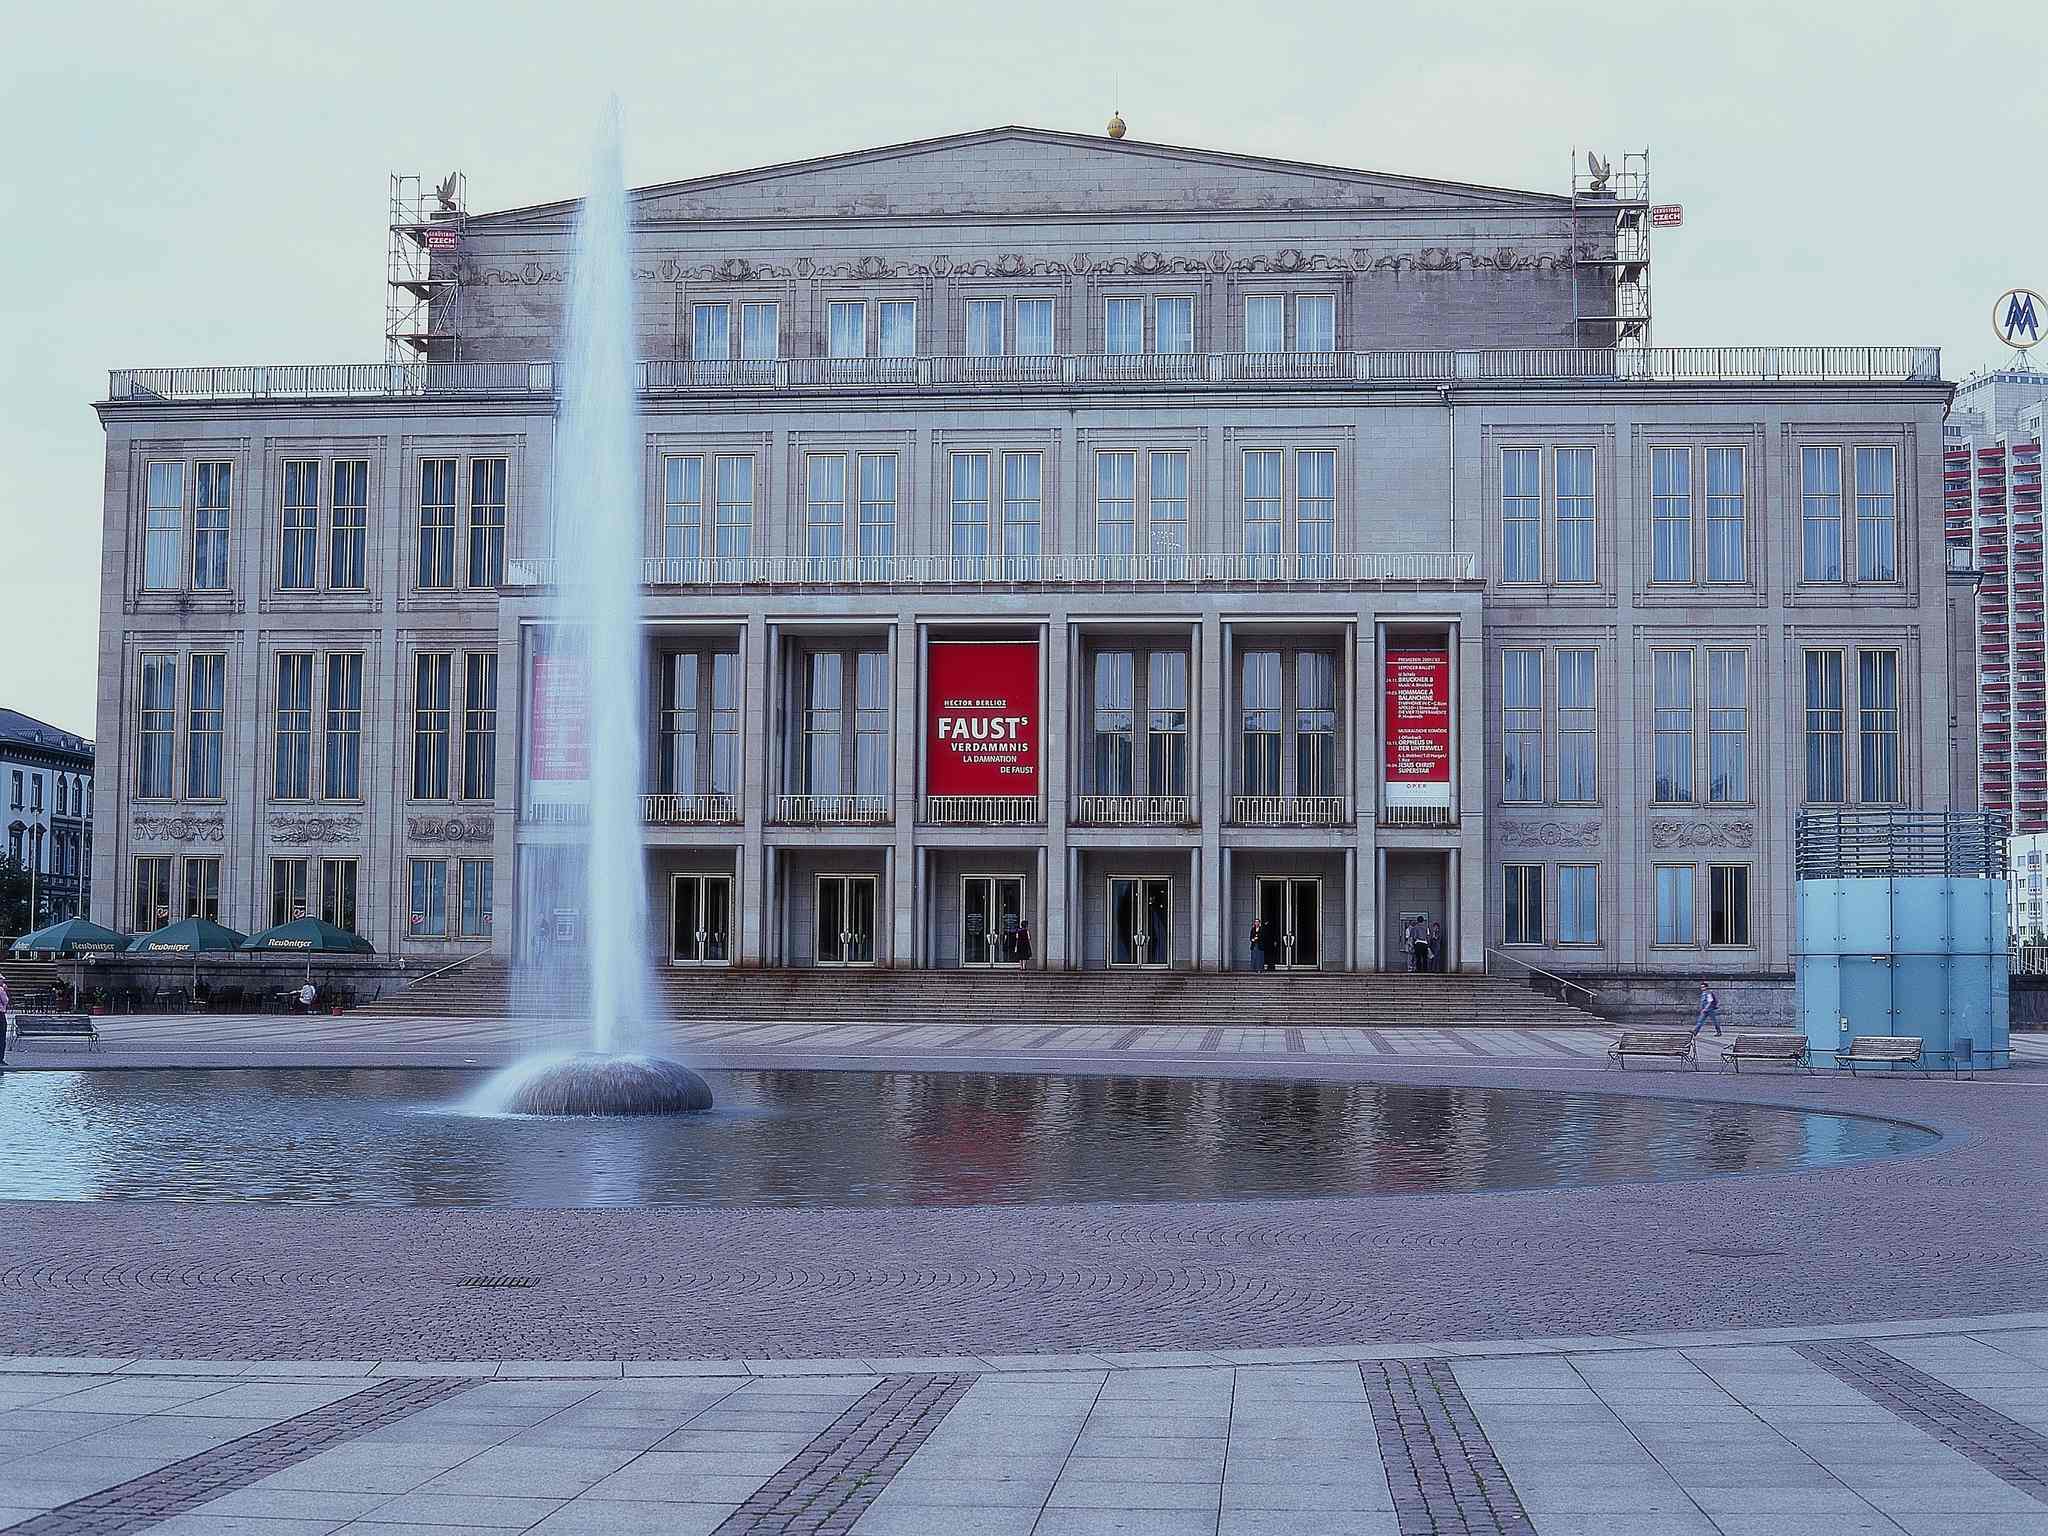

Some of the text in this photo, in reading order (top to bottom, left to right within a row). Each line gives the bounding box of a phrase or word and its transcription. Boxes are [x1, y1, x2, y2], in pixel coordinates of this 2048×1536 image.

[951, 742, 1029, 752] VERDAMMNIS
[963, 755, 1017, 763] LA DAMNATION
[1000, 766, 1034, 774] DE FAUST
[71, 942, 115, 951] Reudnitzer
[148, 942, 191, 952] Reudnitzer
[268, 938, 313, 949] Reudnitzer
